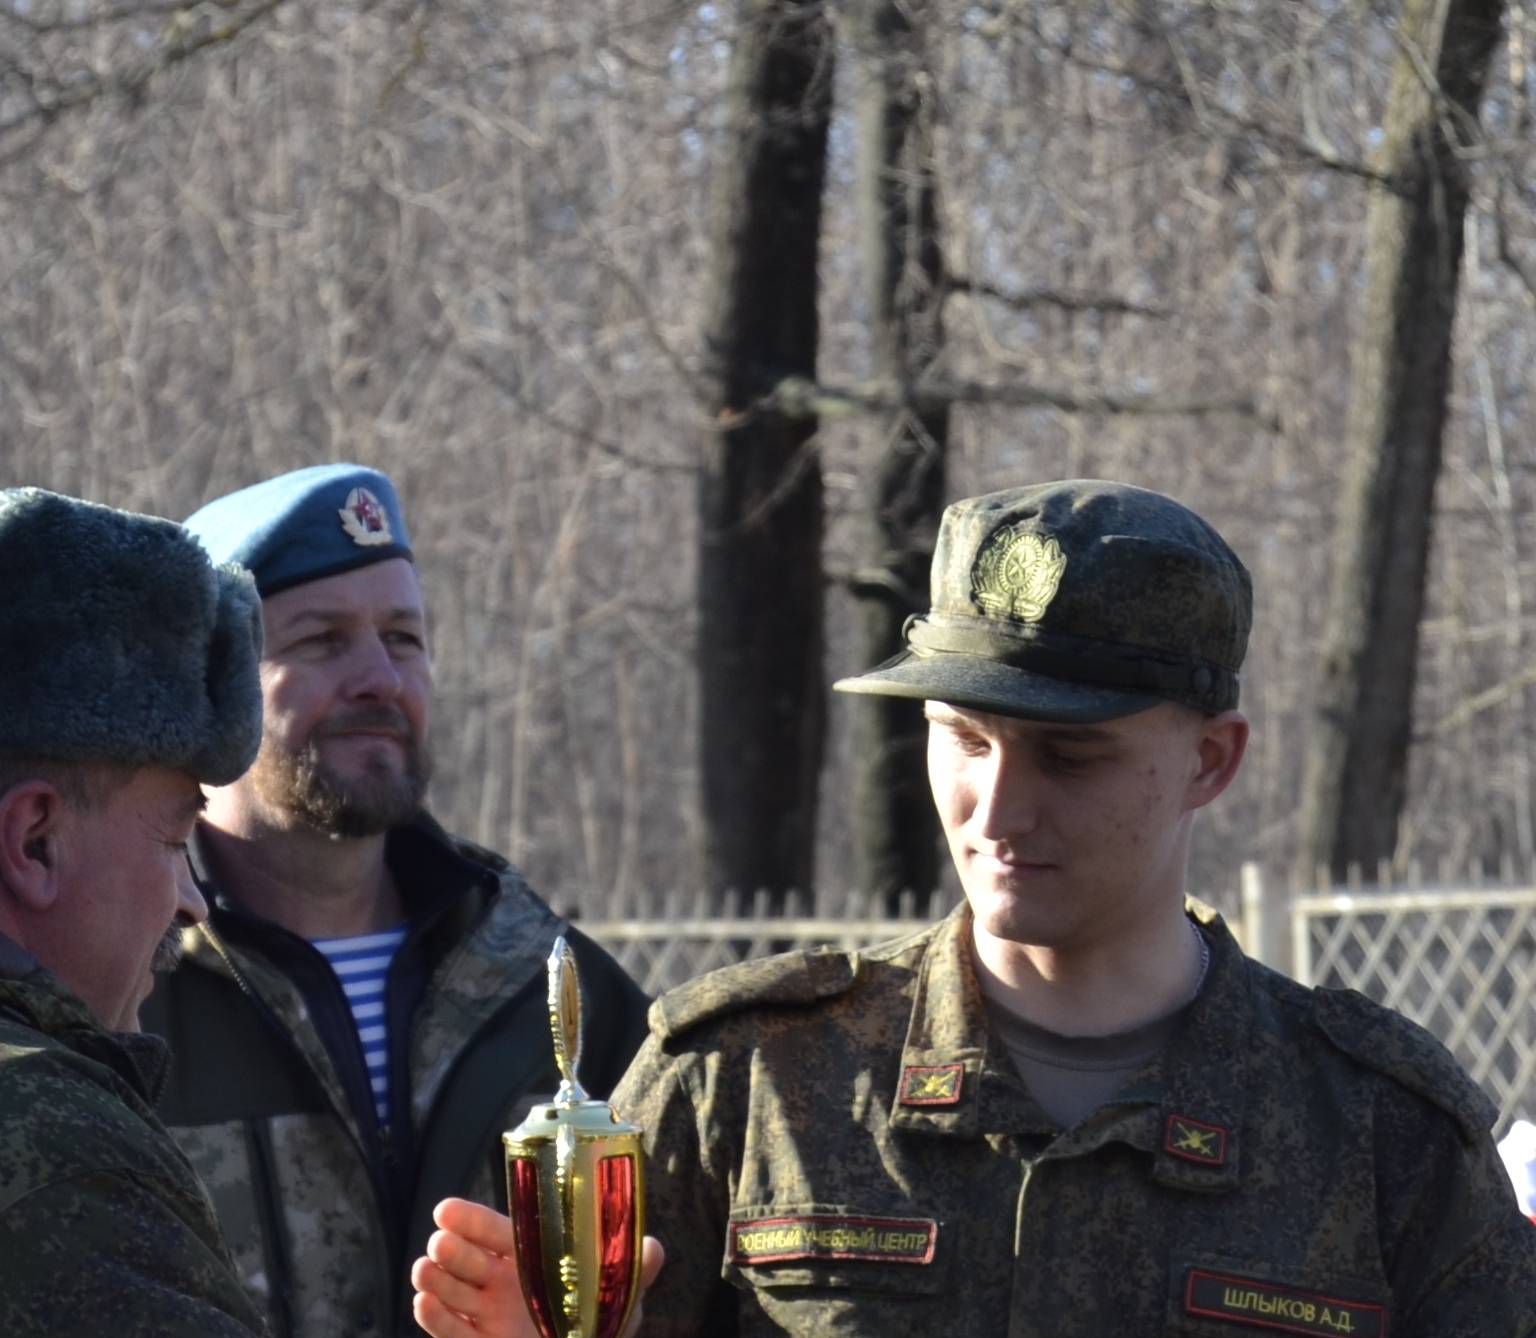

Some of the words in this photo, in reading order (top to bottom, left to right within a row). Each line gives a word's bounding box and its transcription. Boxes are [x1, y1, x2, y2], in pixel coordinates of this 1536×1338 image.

[737, 1226, 801, 1252] ВОЕННЫЙ
[803, 1226, 874, 1250] УЧЕБНЫЙ
[879, 1231, 928, 1253] ЦЕНТР
[1224, 1287, 1316, 1323] ШЛЫКОВ
[1319, 1307, 1355, 1333] А.Д.
